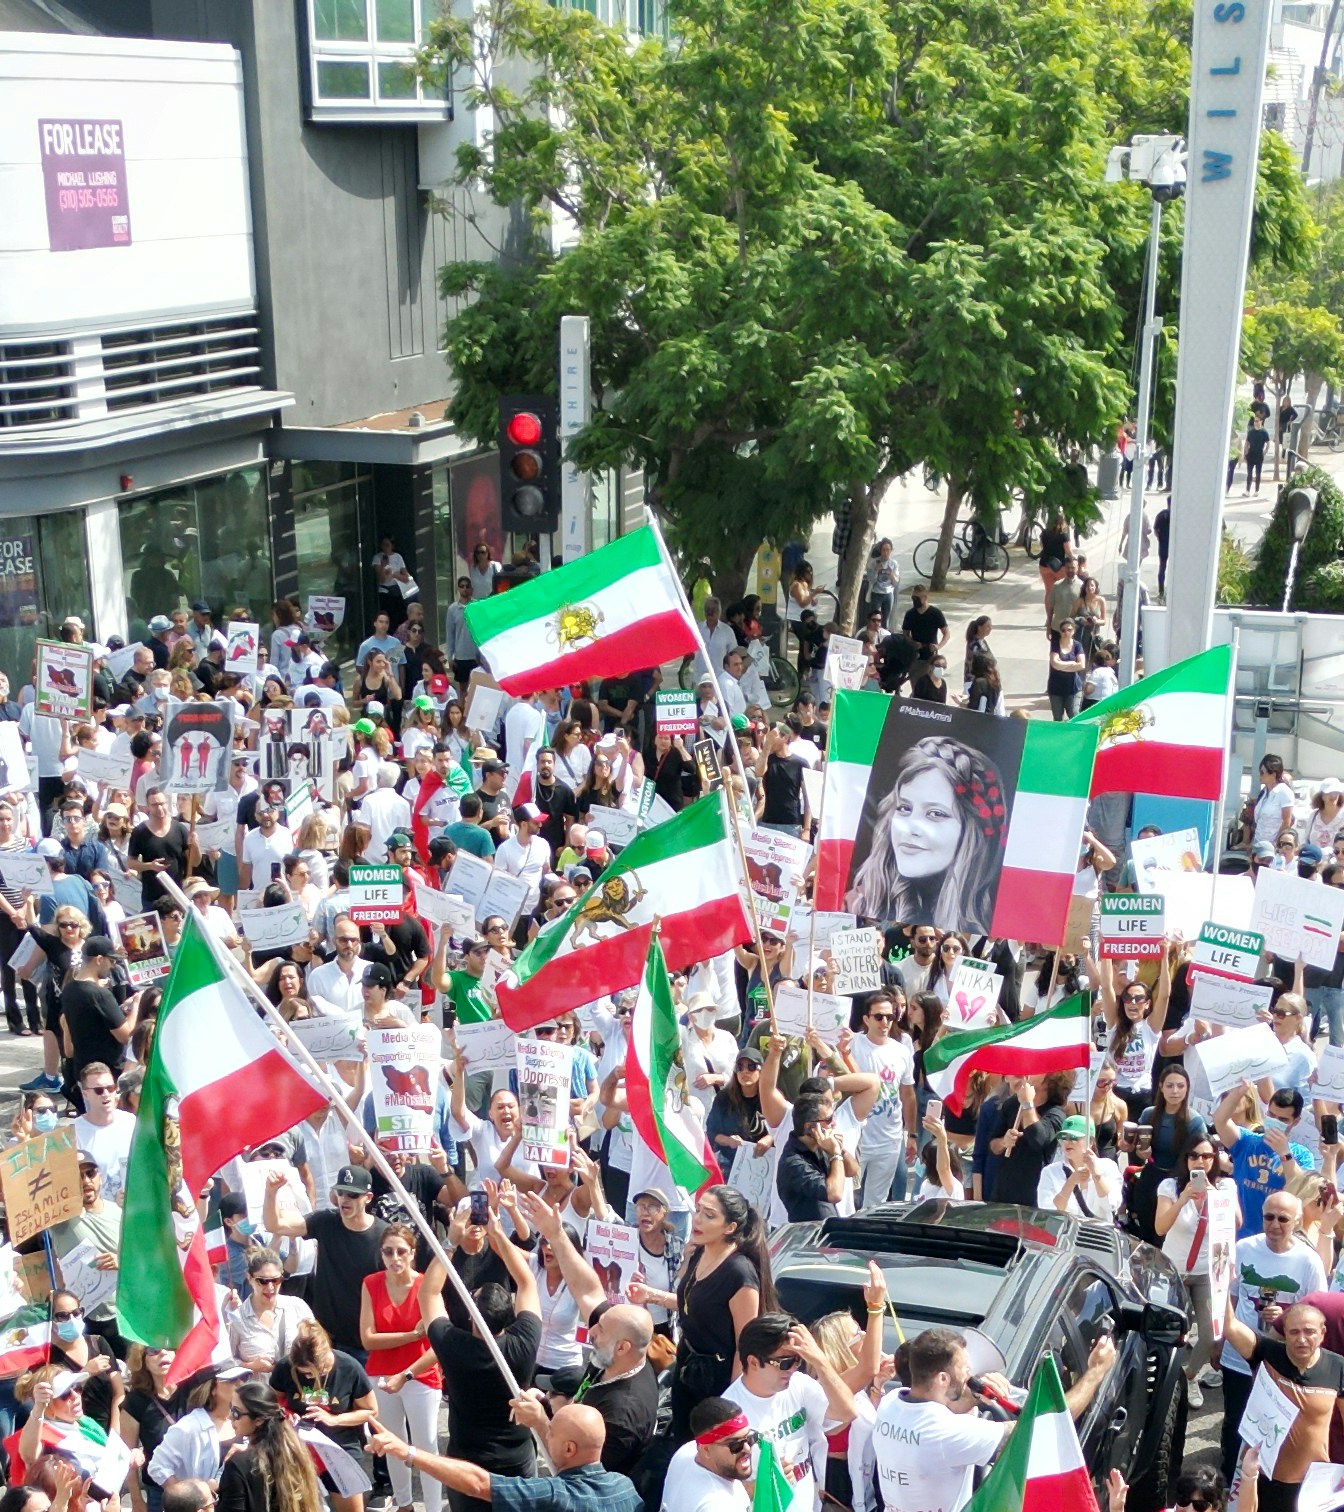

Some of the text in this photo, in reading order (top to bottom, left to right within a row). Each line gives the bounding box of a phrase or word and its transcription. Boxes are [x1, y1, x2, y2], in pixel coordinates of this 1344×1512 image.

[43, 123, 122, 155] FOR LEASE
[57, 171, 117, 187] MICHAEL LUSHING
[60, 188, 118, 212] (310) 505-0565
[657, 693, 695, 703] WOMEN
[667, 707, 687, 718] LIFE
[659, 722, 696, 732] FREEDOM
[639, 782, 655, 818] WOMEN
[353, 868, 400, 881] WOMEN
[364, 888, 389, 901] LIFE
[1104, 898, 1163, 912] WOMEN
[353, 909, 400, 921] FREEDOM
[1118, 919, 1147, 933] LIFE
[838, 934, 872, 946] STAND
[1203, 928, 1262, 949] WOMEN
[1103, 942, 1161, 954] FREEDOM
[835, 956, 880, 976] SISTERS
[1210, 953, 1241, 969] LIFE
[837, 974, 878, 991] OF IRAN
[957, 972, 994, 994] NIKA
[6, 1130, 72, 1178] IRAN
[14, 1186, 71, 1226] ISLAMIC
[13, 1205, 71, 1241] REPUBLIC
[881, 1463, 911, 1487] LIFE
